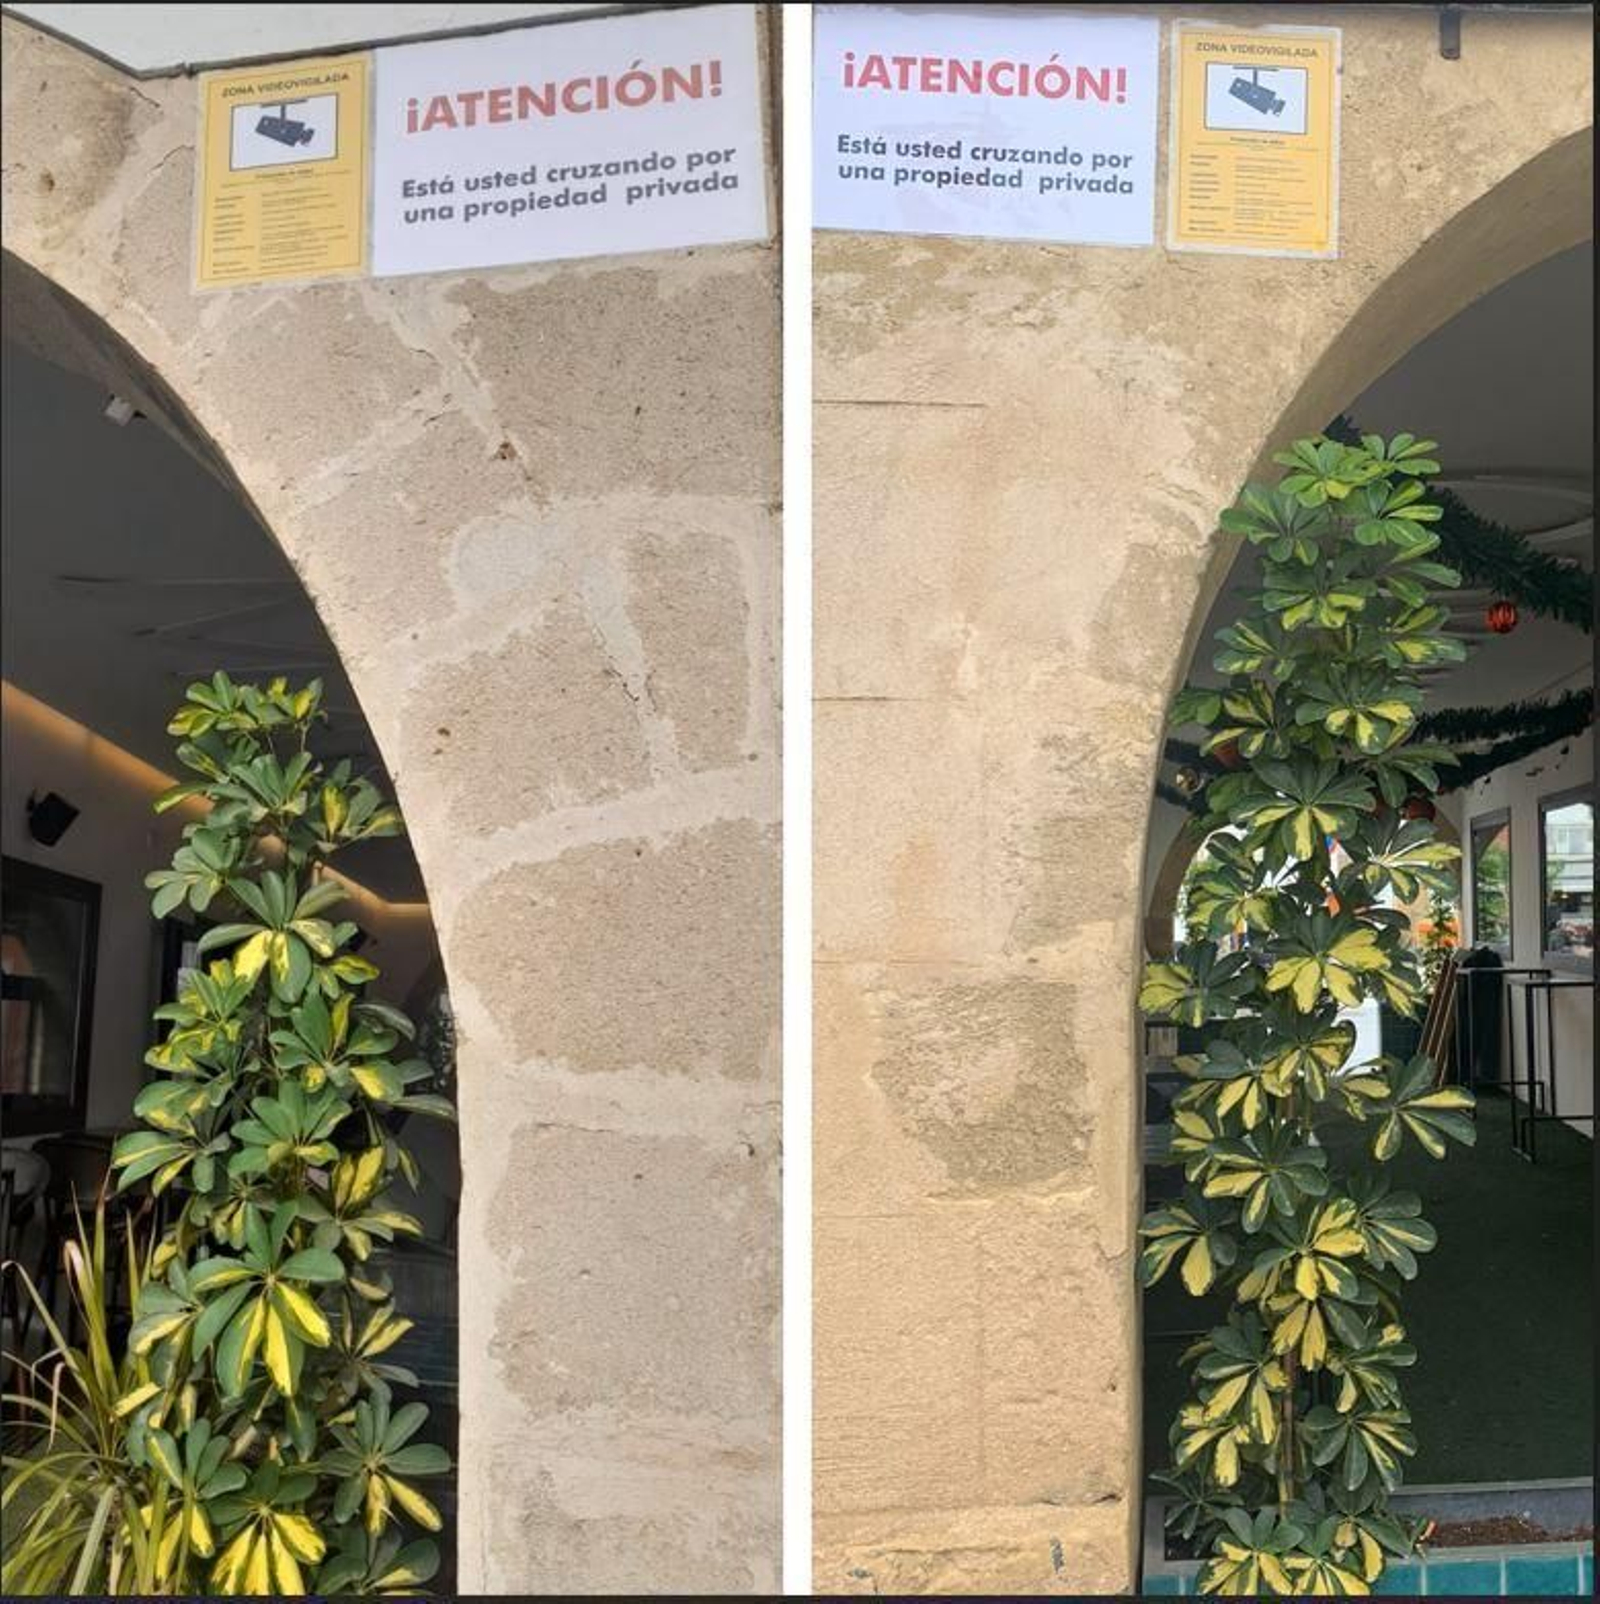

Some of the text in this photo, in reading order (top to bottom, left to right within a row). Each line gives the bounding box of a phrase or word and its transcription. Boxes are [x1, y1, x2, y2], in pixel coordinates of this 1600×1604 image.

[1196, 42, 1319, 58] ZONA VIDEOVIGILADA
[221, 74, 349, 98] ZONA VIDEOVIGILADA
[407, 59, 722, 133] ¡ATENCIÓN!
[843, 52, 1127, 104] ¡ATENCIÓN!
[402, 147, 736, 198] Está usted cruzando por
[838, 135, 1133, 171] Está usted cruzando por
[404, 171, 738, 223] una propiedad privada
[839, 165, 1133, 194] una propiedad privada
